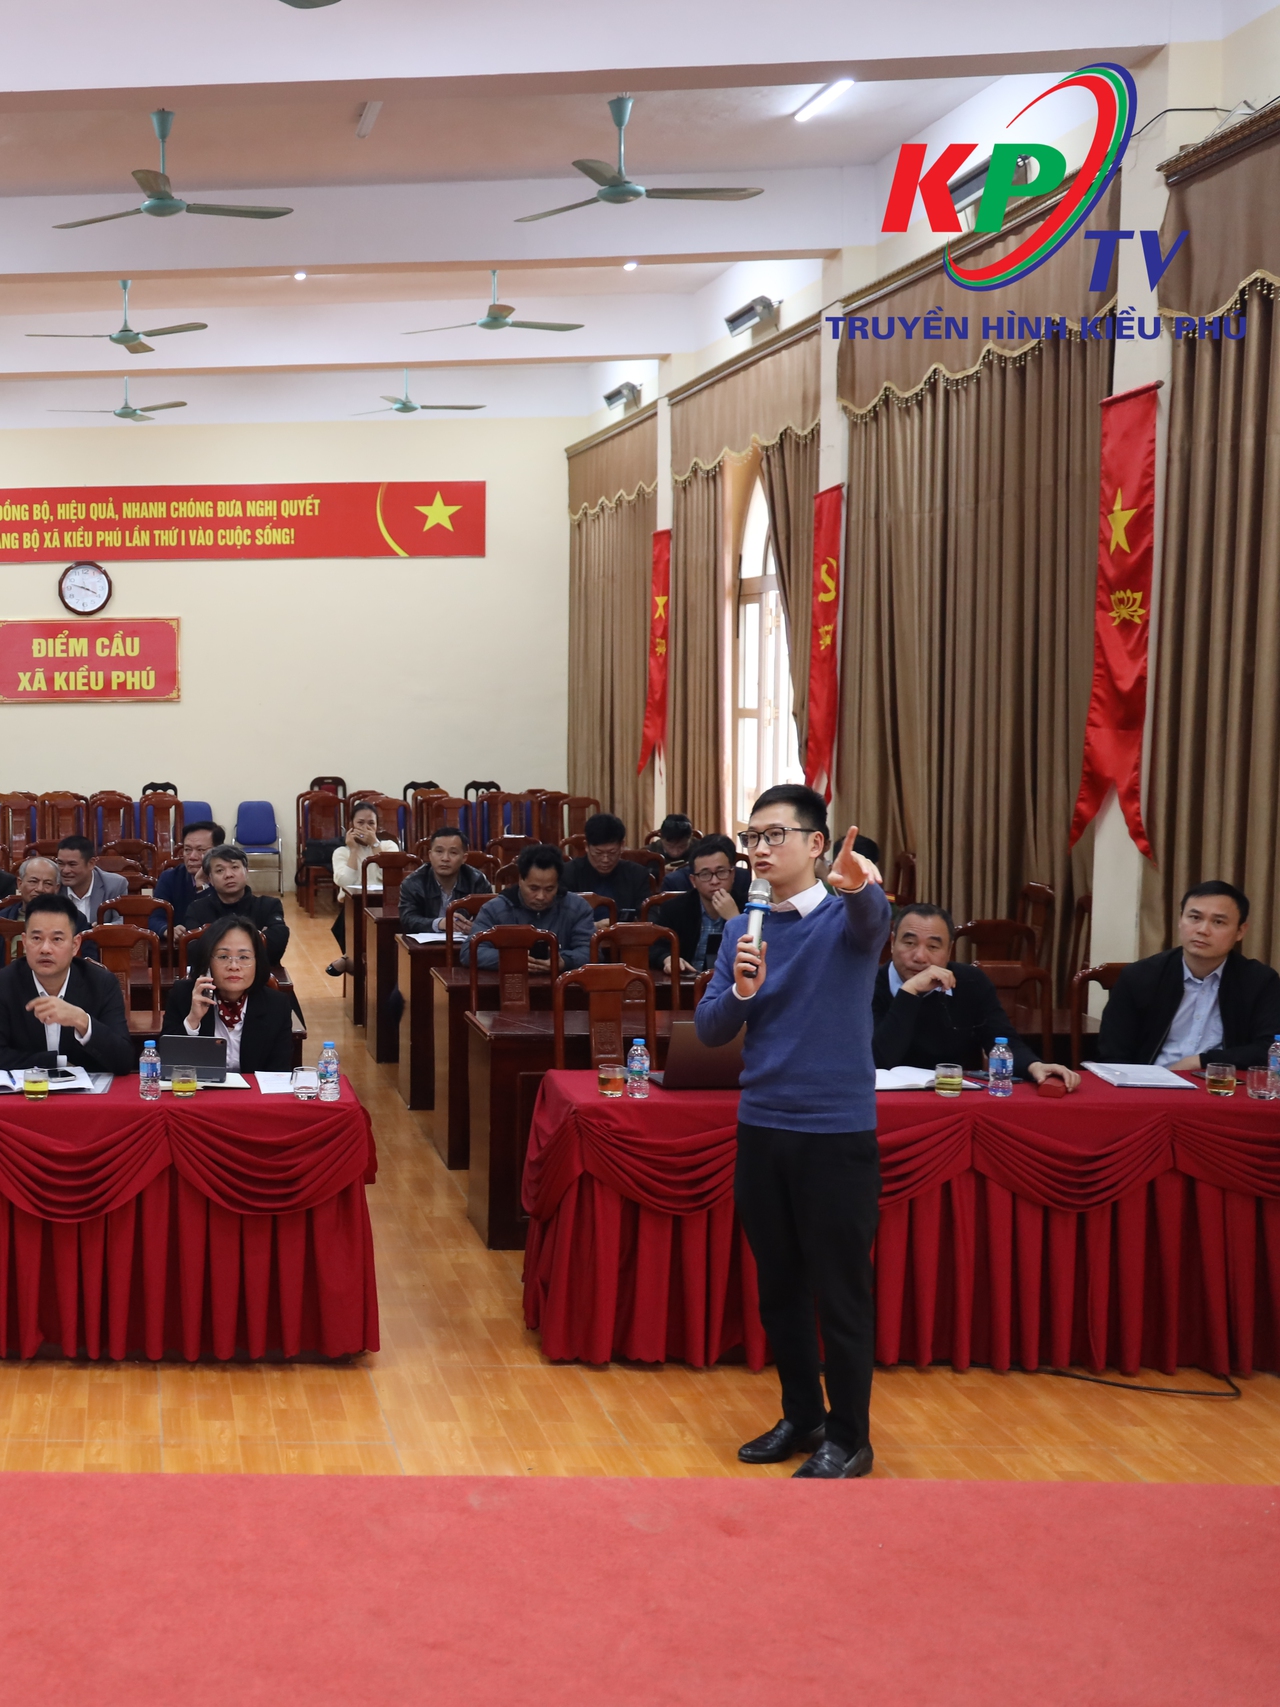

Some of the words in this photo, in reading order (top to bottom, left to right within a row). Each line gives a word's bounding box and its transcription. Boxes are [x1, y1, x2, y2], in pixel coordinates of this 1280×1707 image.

[33, 500, 54, 523] BỘ,
[57, 500, 86, 523] HIỆU
[89, 497, 119, 521] QUẢ,
[122, 501, 167, 519] NHANH
[170, 498, 214, 518] CHÓNG
[217, 499, 243, 518] ĐƯA
[246, 500, 278, 520] NGHỊ
[280, 494, 321, 518] QUYẾT
[22, 529, 40, 552] BỘ
[43, 529, 61, 548] XÃ
[63, 526, 93, 548] KIỀU
[96, 527, 122, 547] PHÚ
[125, 525, 150, 547] LẦN
[153, 526, 179, 546] THỨ
[181, 529, 186, 547] I
[189, 526, 214, 546] VÀO
[217, 526, 252, 549] CUỘC
[255, 523, 295, 546] SỐNG!
[32, 630, 89, 658] ĐIỂM
[95, 630, 141, 657] CẦU
[17, 667, 48, 692] XÃ
[53, 665, 105, 691] KIỀU
[111, 666, 156, 691] PHÚ
